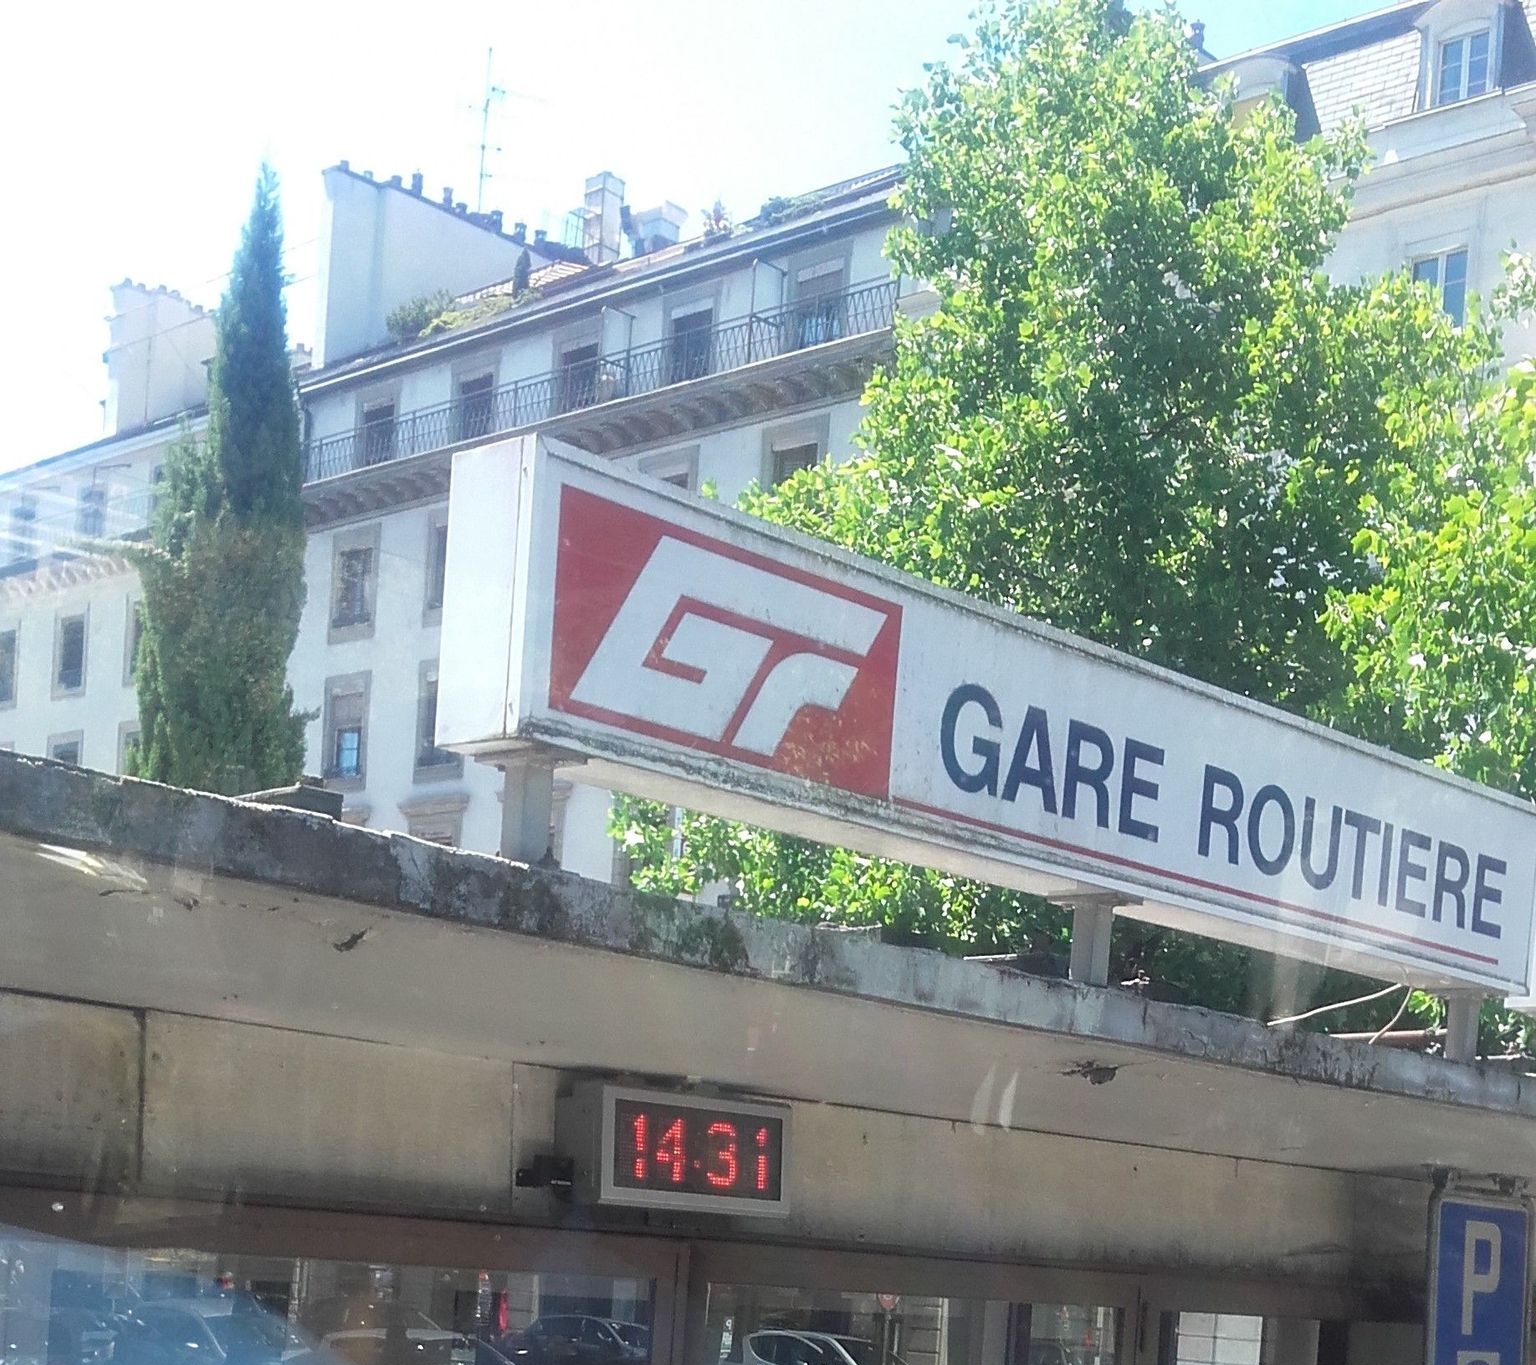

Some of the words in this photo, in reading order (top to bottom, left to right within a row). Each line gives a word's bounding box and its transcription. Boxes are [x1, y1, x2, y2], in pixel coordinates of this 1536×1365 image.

[940, 683, 1166, 843] GARE
[1197, 763, 1507, 938] ROUTIERE
[1461, 1220, 1501, 1335] P
